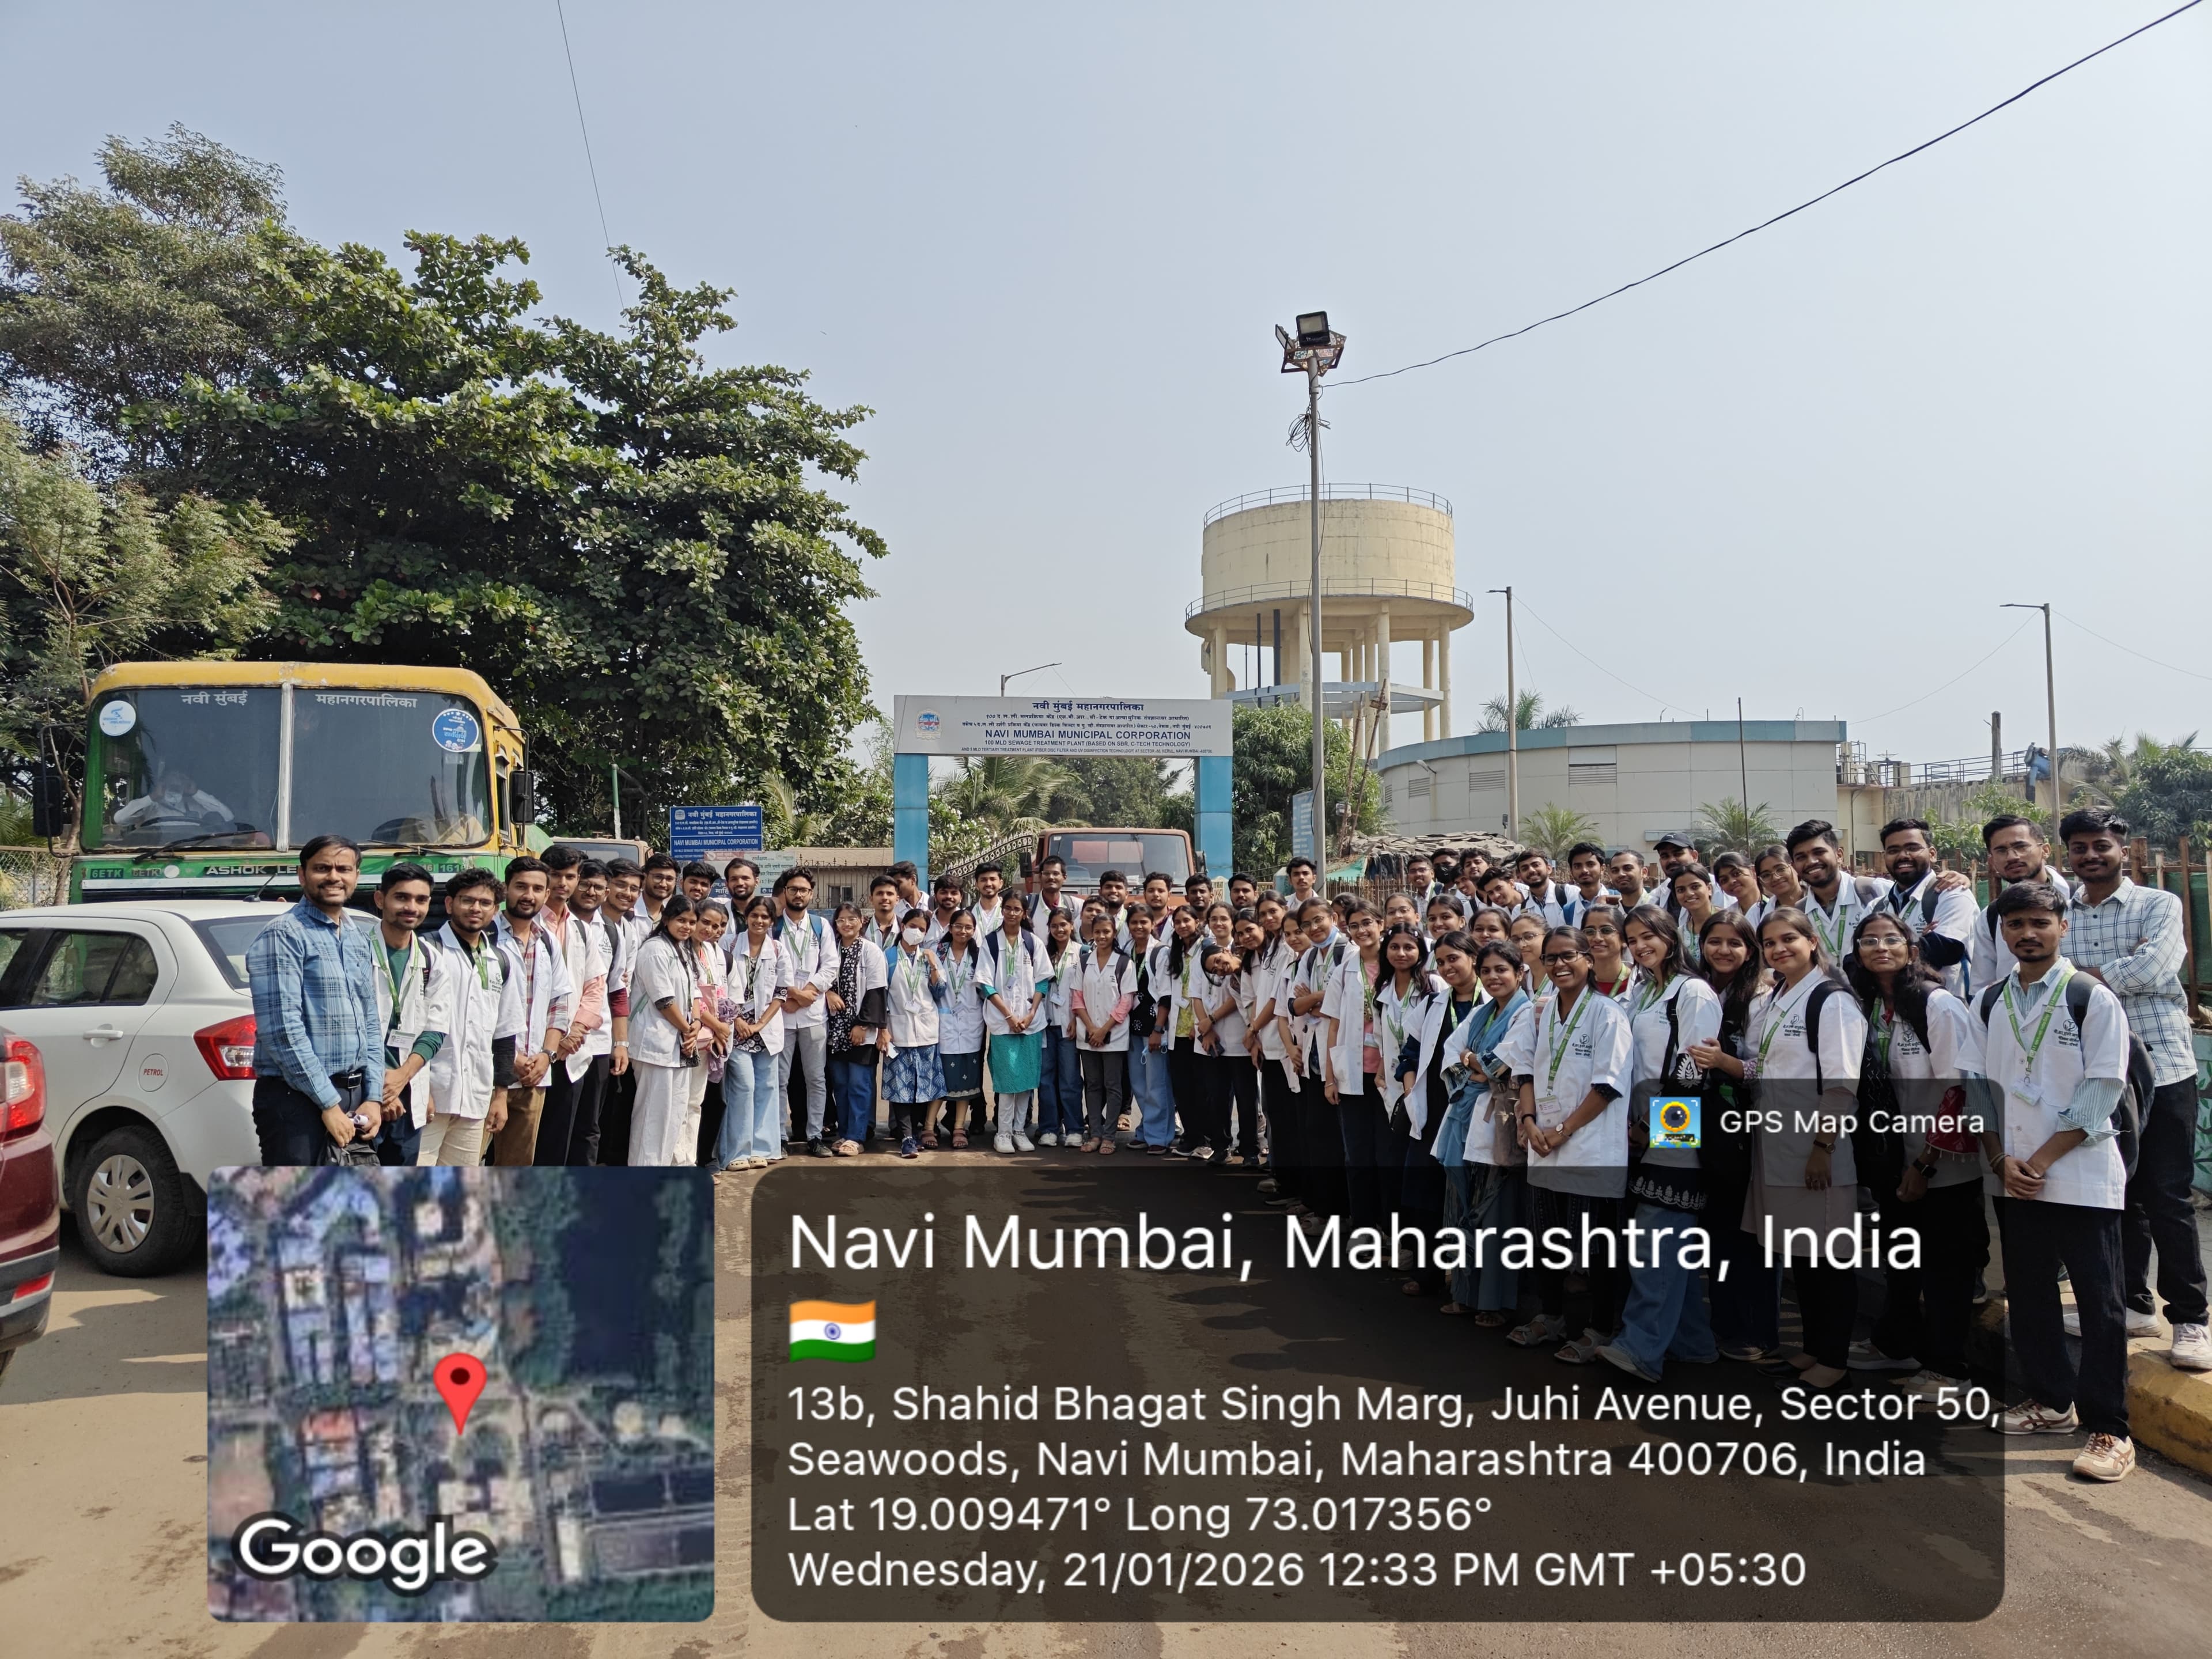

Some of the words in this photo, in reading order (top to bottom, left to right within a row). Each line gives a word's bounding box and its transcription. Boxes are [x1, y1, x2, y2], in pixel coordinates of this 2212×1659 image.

[180, 691, 211, 704] नवी
[213, 690, 248, 706] मुंबई
[315, 693, 418, 708] महानगरपालिका
[1032, 700, 1050, 710] नवी
[1052, 700, 1073, 713] मुंबई
[1076, 701, 1144, 711] महानगरपालिका
[986, 729, 1009, 738] NAVI
[1013, 730, 1055, 738] MUMBAI
[1058, 730, 1113, 739] MUNICIPAL
[1116, 731, 1191, 740] CORPORATION
[700, 810, 713, 819] मुंबई
[92, 869, 123, 878] 6ETK
[206, 866, 268, 875] ASHOK
